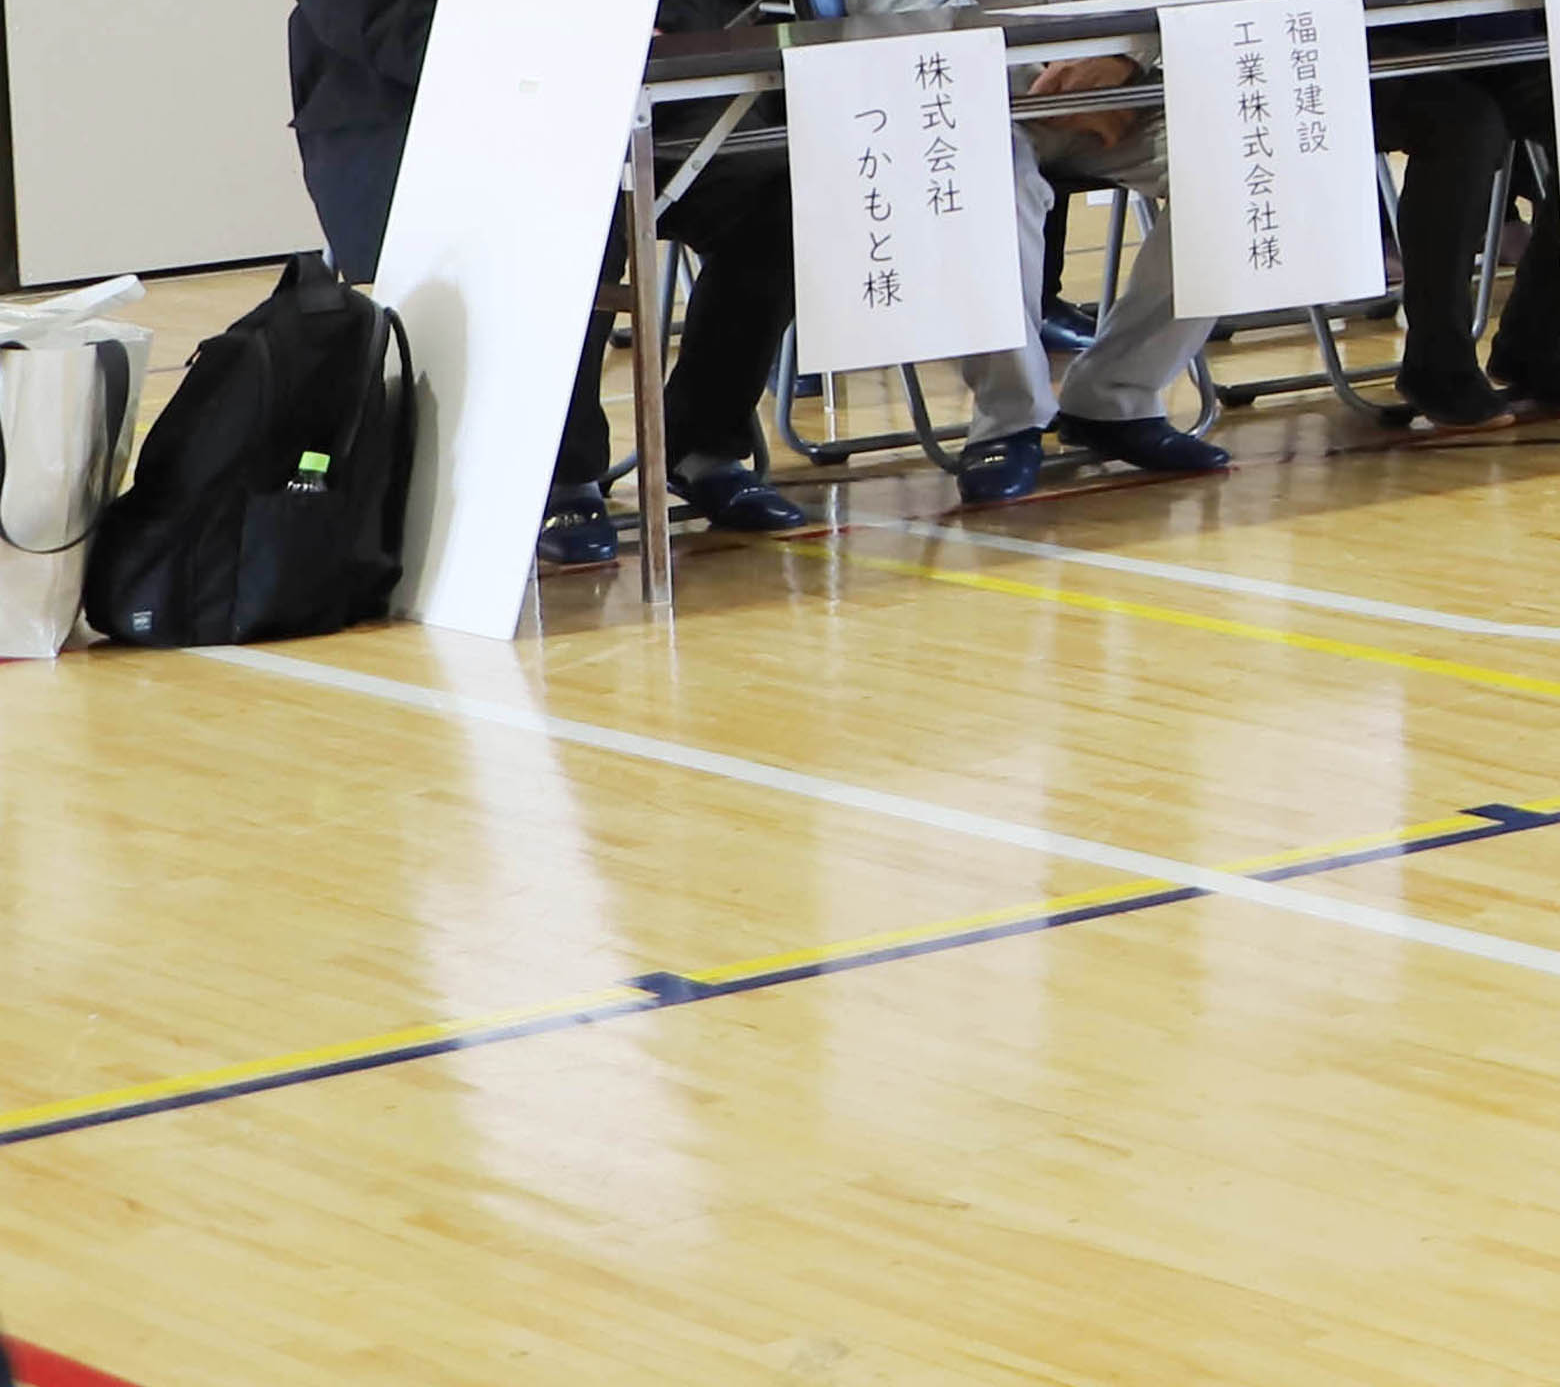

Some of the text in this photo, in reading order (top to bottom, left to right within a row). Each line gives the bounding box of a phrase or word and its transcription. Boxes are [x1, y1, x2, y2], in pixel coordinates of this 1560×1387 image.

[914, 51, 964, 216] 株式会社
[1233, 21, 1283, 271] 工業株式会社様
[1285, 11, 1329, 154] 福智建設
[853, 108, 903, 309] つかもと様
